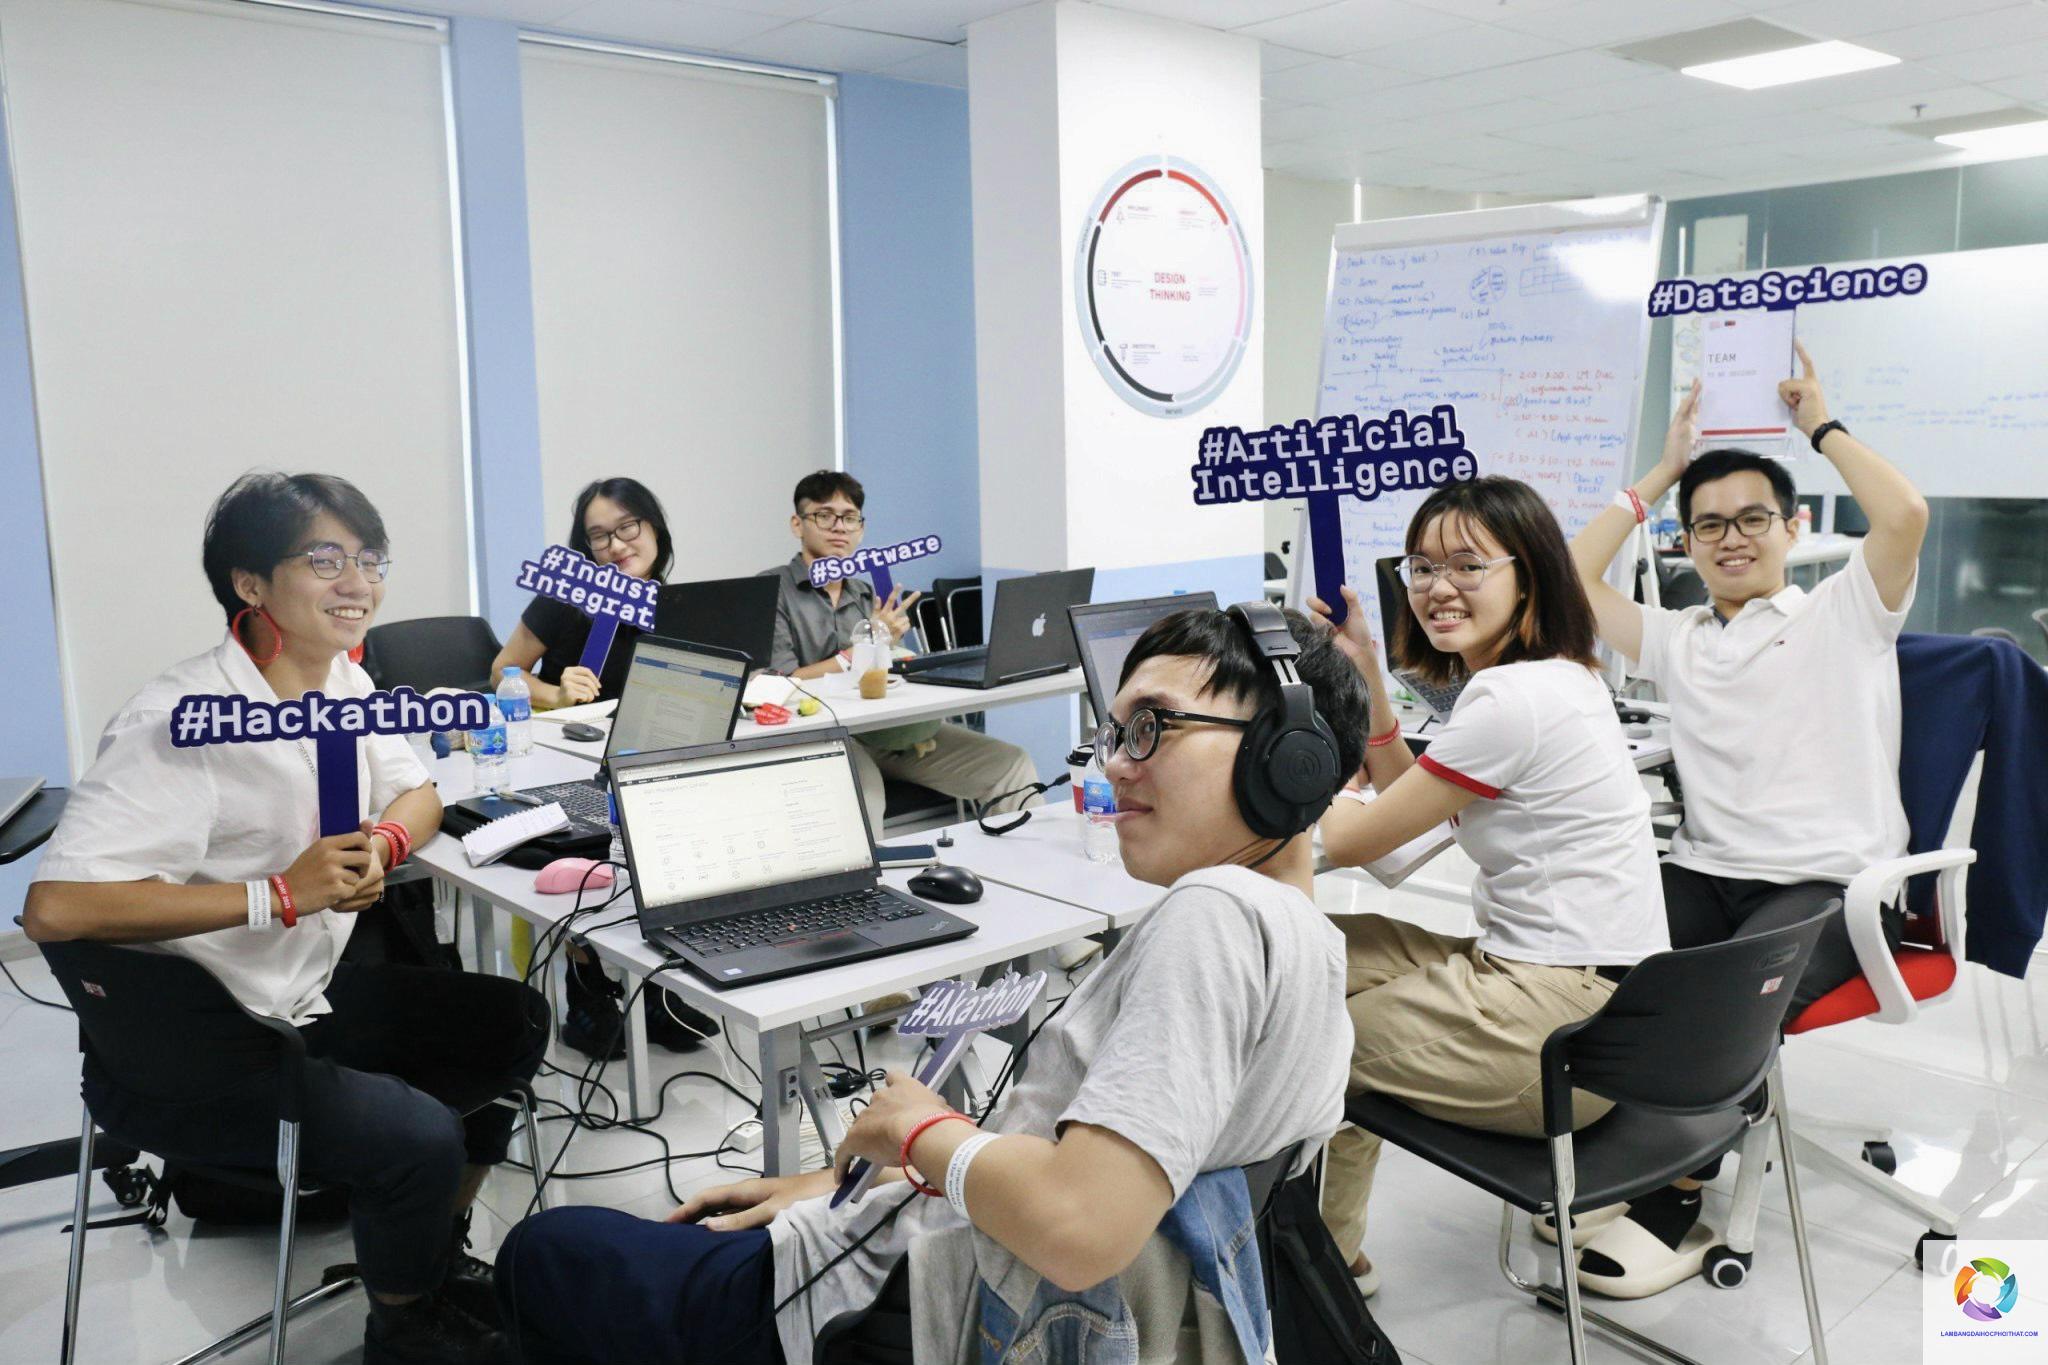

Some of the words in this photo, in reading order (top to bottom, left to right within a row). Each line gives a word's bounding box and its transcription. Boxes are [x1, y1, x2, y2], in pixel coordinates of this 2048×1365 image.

[1149, 288, 1191, 302] THINKING
[1154, 272, 1186, 284] DESIGN
[1653, 266, 1923, 313] #DataScience
[1707, 352, 1737, 364] TEAM
[1203, 410, 1461, 468] #Artificial
[1195, 454, 1474, 501] Intelligence
[542, 547, 658, 606] #Indust
[812, 536, 940, 584] #Software
[519, 564, 656, 630] Integrat
[177, 690, 484, 741] #Hackathon
